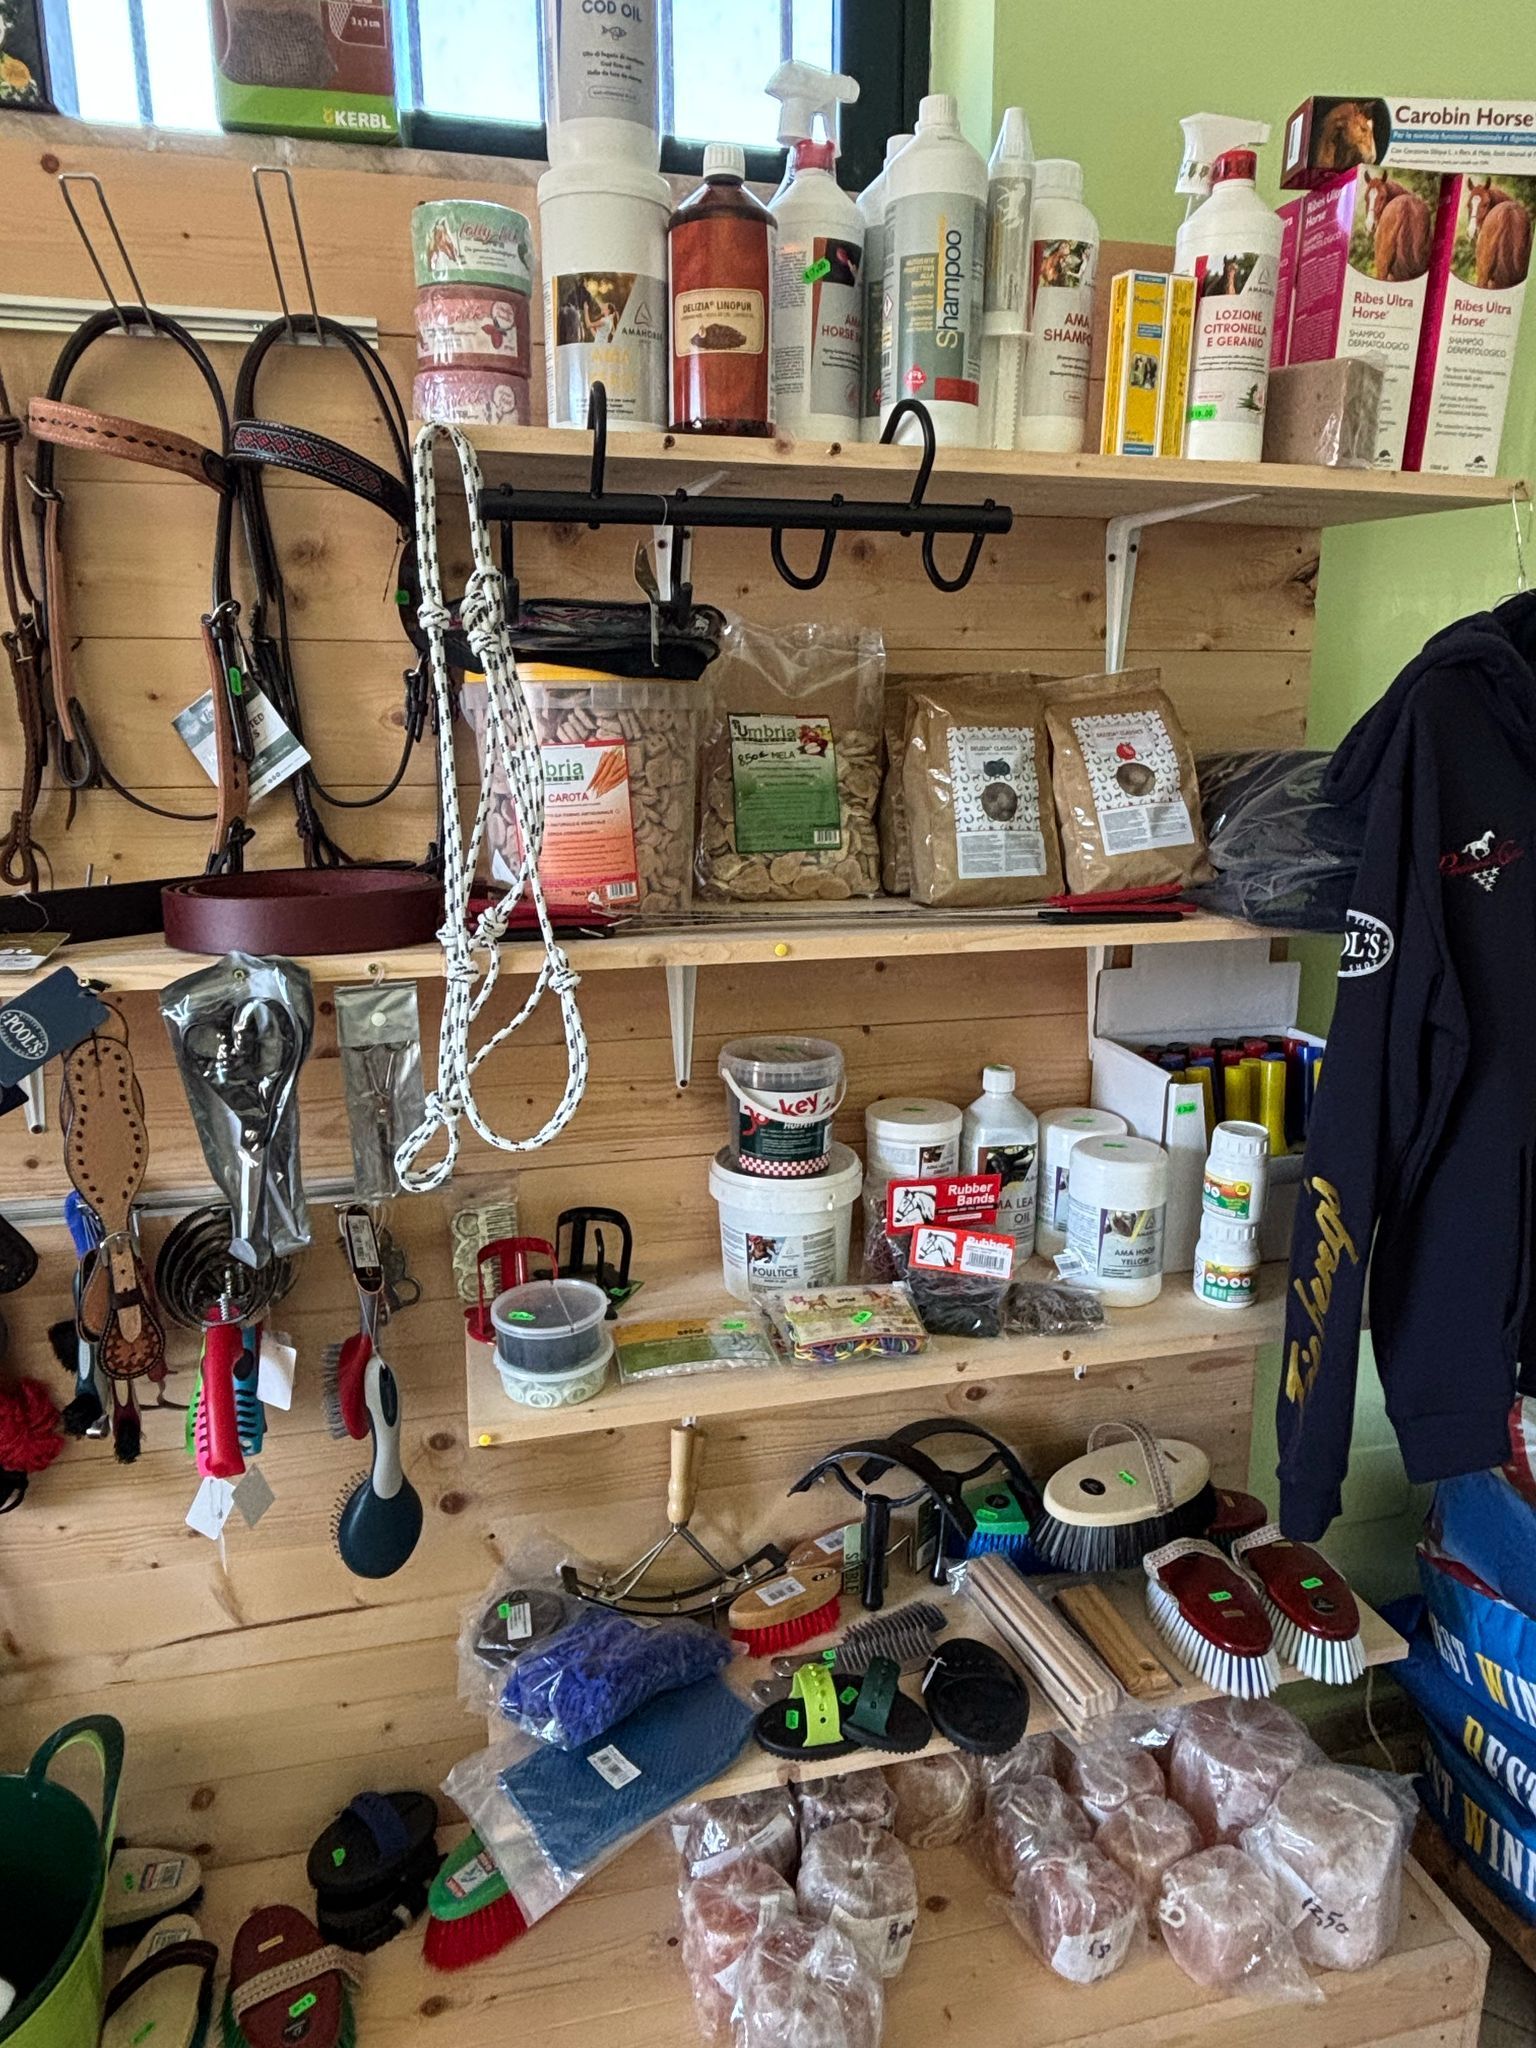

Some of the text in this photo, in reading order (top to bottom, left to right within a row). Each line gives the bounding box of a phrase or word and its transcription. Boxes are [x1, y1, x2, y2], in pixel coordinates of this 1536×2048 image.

[582, 0, 643, 22] COD OIL
[335, 111, 391, 129] KERBL
[1395, 105, 1534, 127] Carobin Horse
[936, 230, 964, 349] Shampoo
[1354, 292, 1414, 308] Ribes Ultra
[1454, 299, 1512, 315] Ribes Ultra
[1064, 313, 1089, 327] AMA
[1216, 309, 1263, 322] LOZIONE
[1352, 307, 1387, 320] Horse
[1451, 315, 1486, 328] Horse
[821, 325, 854, 342] HORSE
[1204, 323, 1267, 337] CITRONELLA
[1349, 330, 1385, 339] SHAMPOO
[1044, 328, 1092, 347] SHAMPO
[1207, 336, 1264, 349] E GERANIO
[1348, 338, 1409, 351] DERMATOLOGICO
[1449, 337, 1484, 346] SHAMPOO
[1447, 346, 1507, 358] DERMATOLOGICO
[738, 720, 796, 738] Umbria
[771, 752, 796, 760] MELA
[548, 792, 590, 803] CAROTA
[4, 1014, 43, 1054] POOL'S
[742, 1092, 818, 1136] Jokey
[948, 1182, 994, 1196] Rubber
[957, 1193, 995, 1207] Bands
[1016, 1196, 1033, 1209] LEA
[753, 1266, 798, 1277] POULTICE
